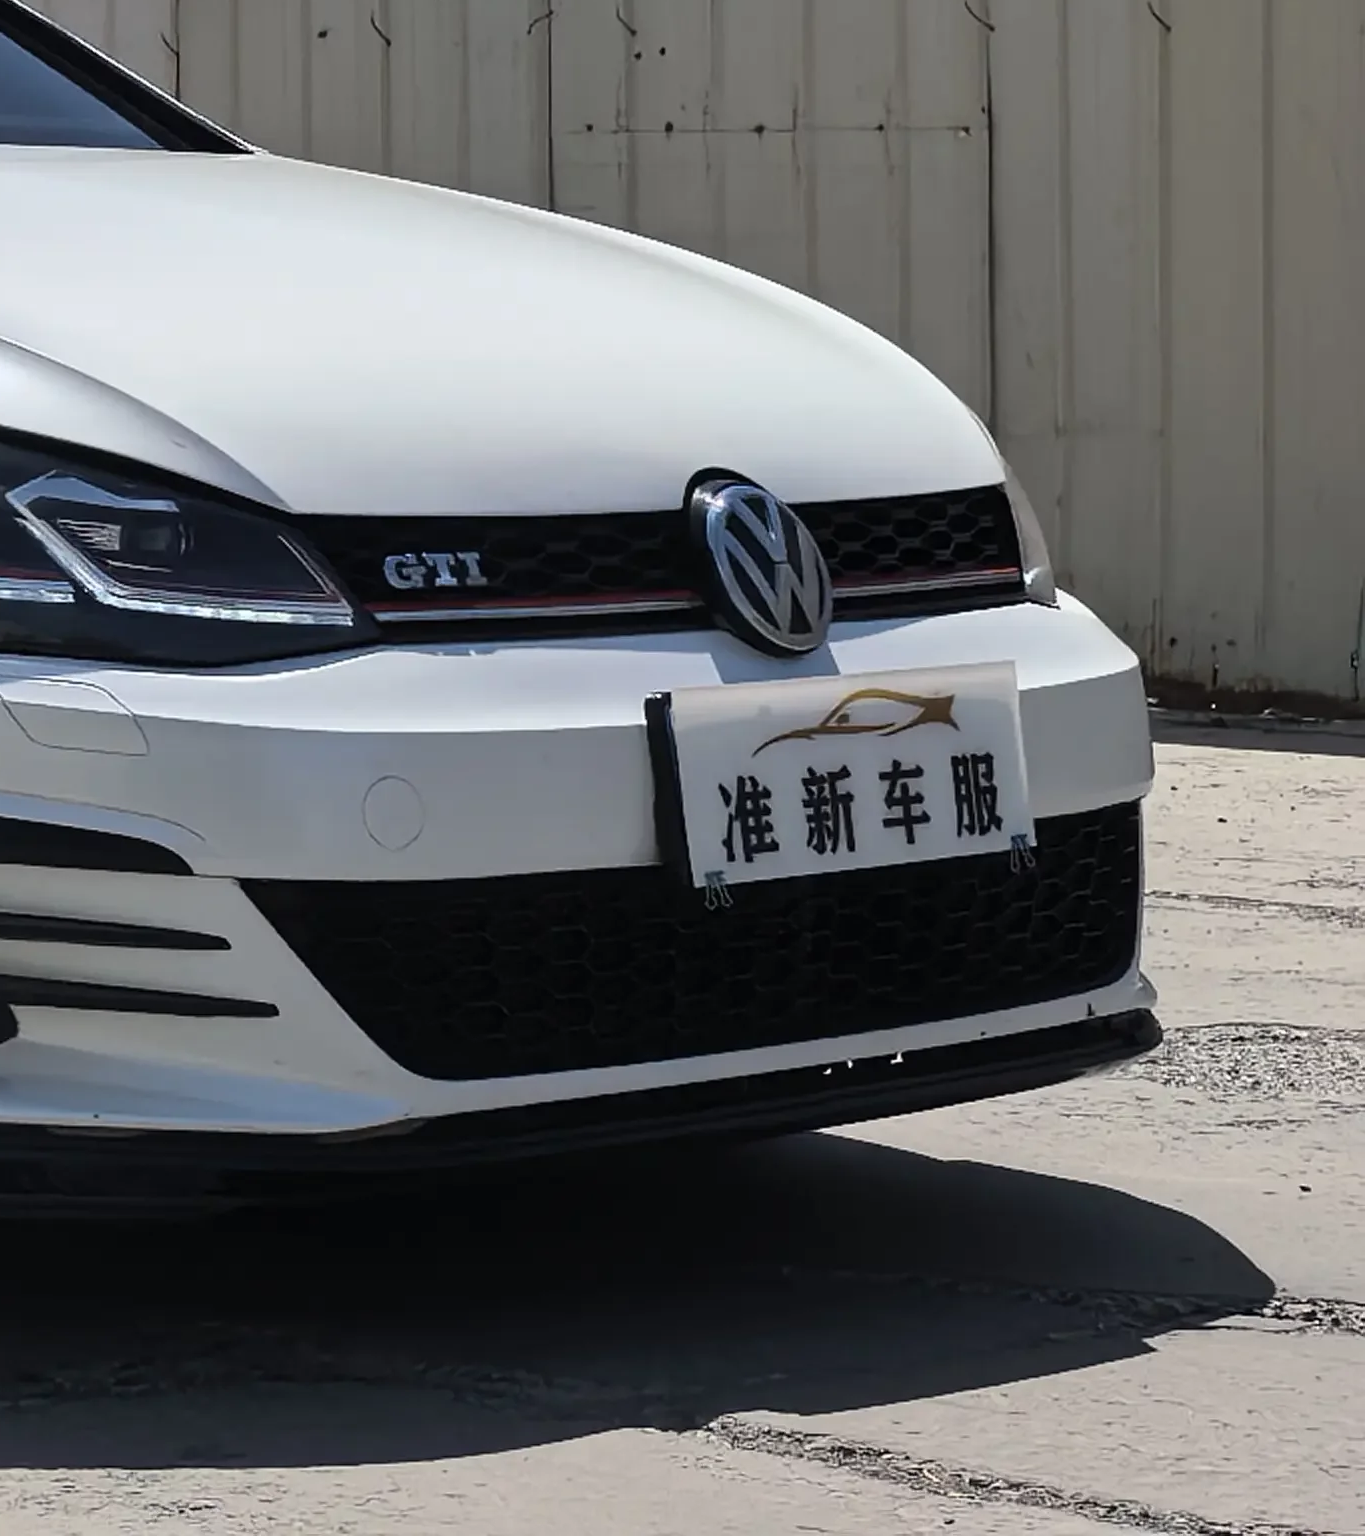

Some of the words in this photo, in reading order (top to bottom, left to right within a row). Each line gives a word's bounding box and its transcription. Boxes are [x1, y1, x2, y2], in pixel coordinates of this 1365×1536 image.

[383, 551, 488, 589] GTI
[717, 751, 1003, 864] 准新车服
